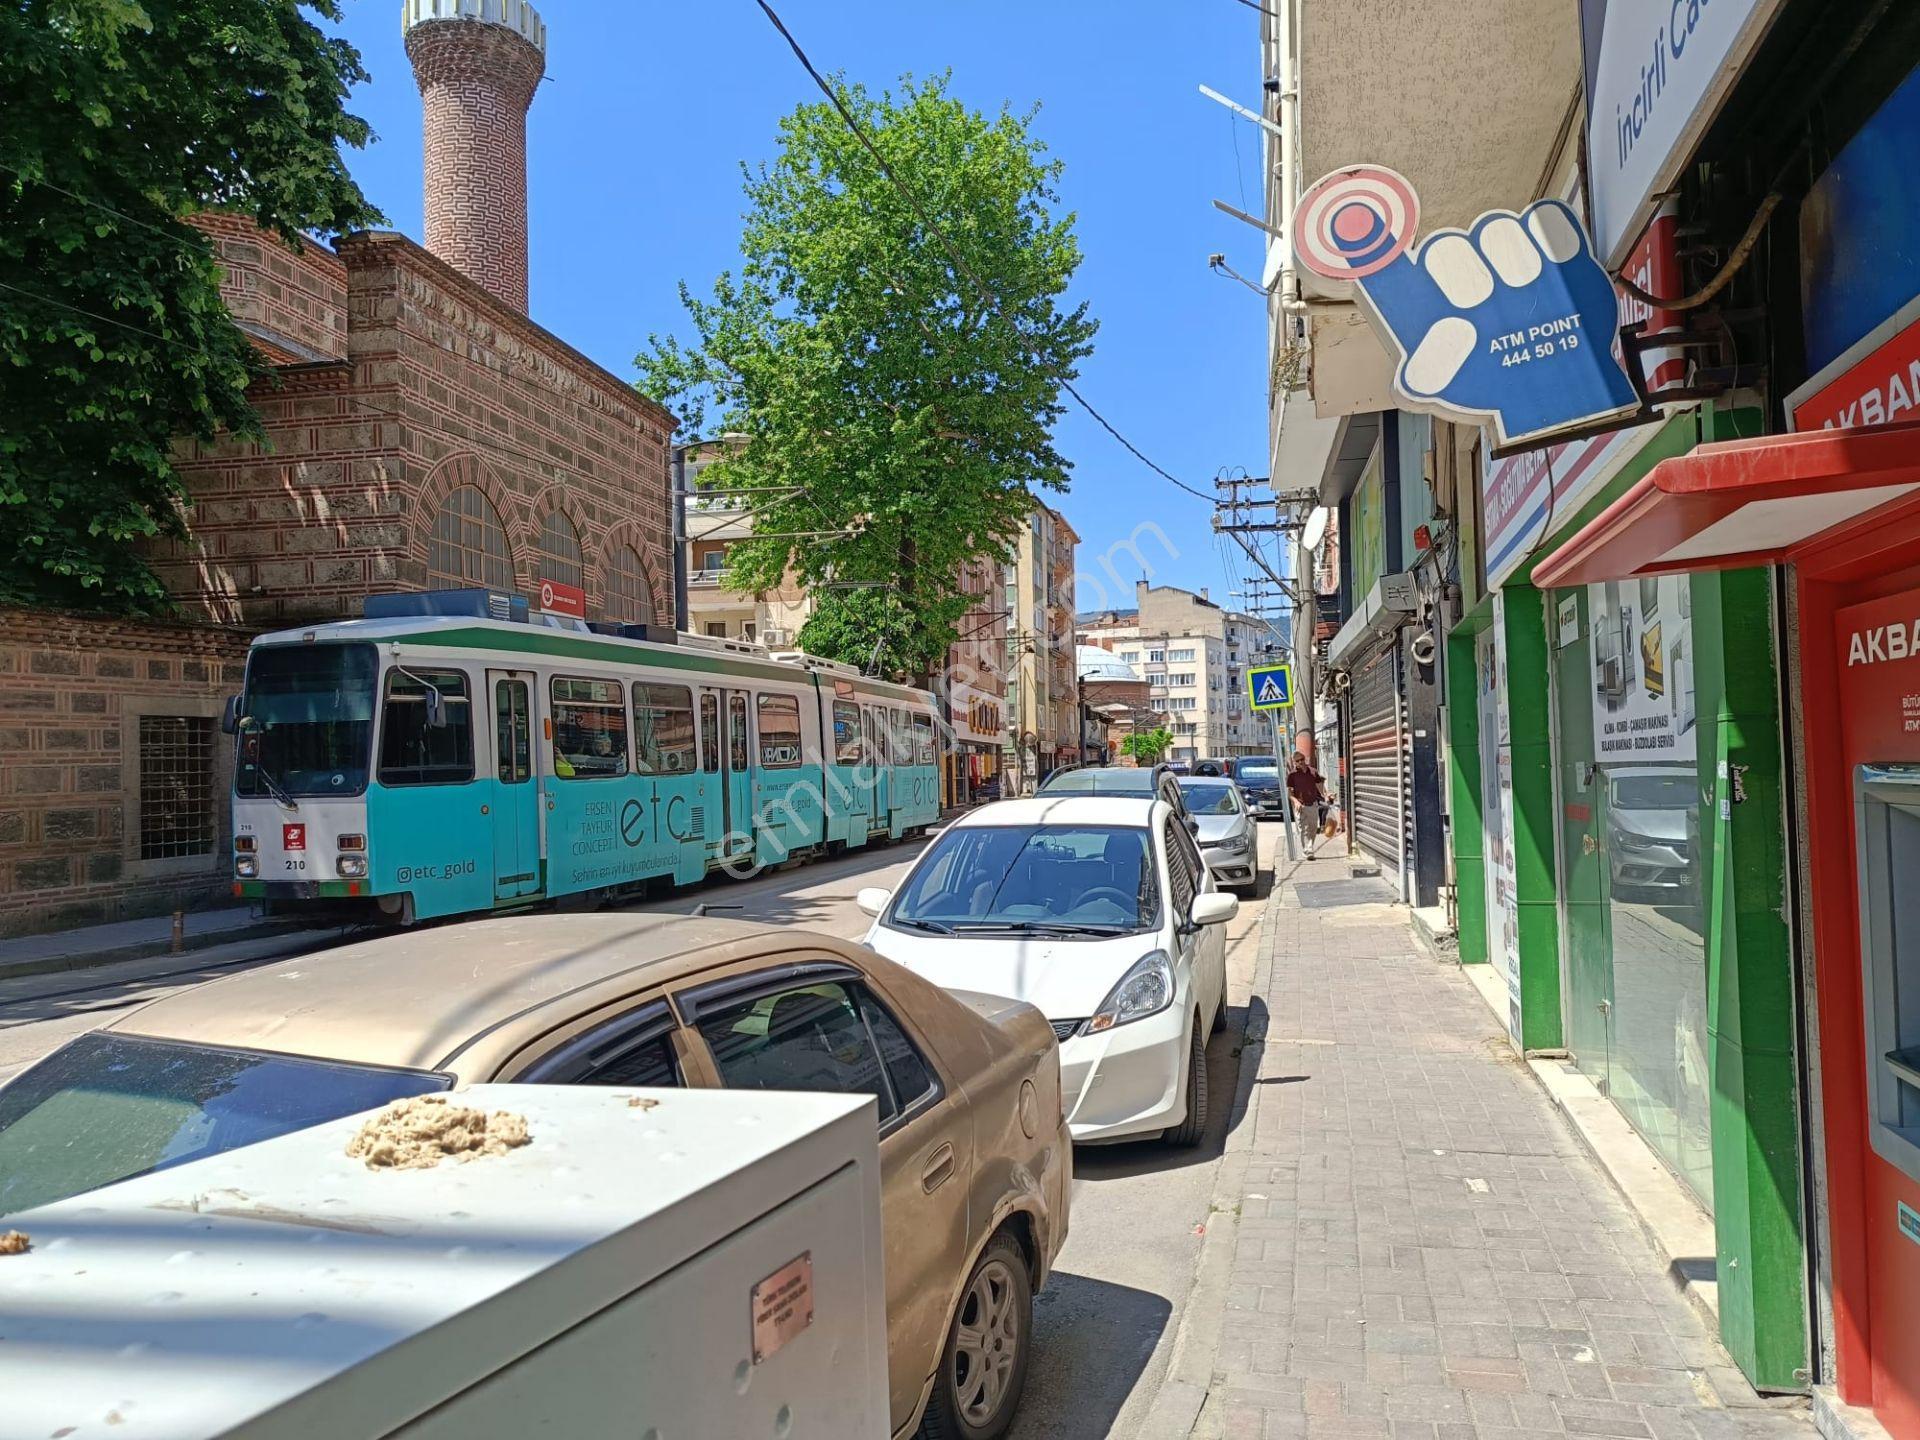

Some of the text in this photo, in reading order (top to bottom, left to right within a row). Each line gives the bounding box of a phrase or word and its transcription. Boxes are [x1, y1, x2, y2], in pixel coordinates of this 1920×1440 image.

[1617, 0, 1708, 170] incirli Ca
[1490, 313, 1581, 354] ATM POINT
[1502, 334, 1578, 368] 444 50 19
[1902, 694, 1920, 709] BÜTÜ
[585, 801, 612, 816] ERSEN
[581, 819, 614, 835] TAYFUR
[572, 838, 614, 856] CONCEPT
[285, 860, 306, 870] 210
[414, 859, 475, 880] etc_gold
